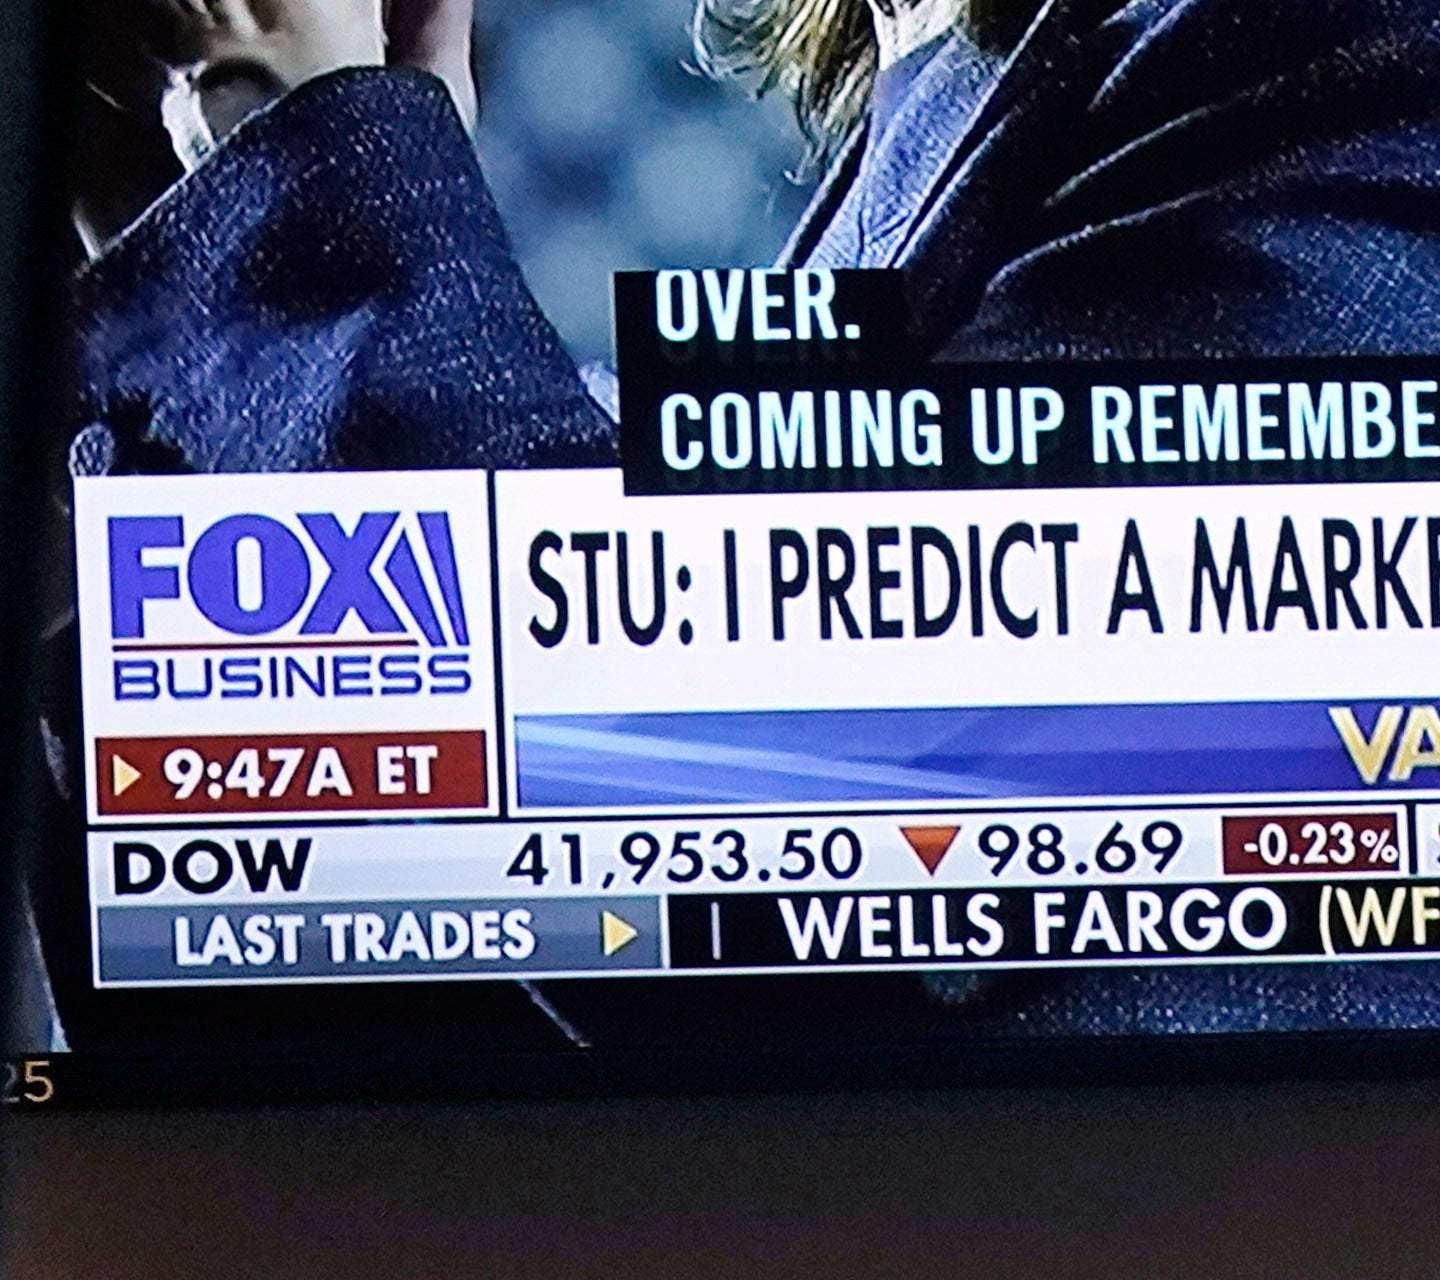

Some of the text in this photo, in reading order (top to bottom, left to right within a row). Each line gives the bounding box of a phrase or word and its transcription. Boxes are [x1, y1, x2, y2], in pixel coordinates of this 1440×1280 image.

[654, 270, 862, 343] OVER.
[659, 388, 944, 472] COMING
[969, 386, 1066, 466] UP
[107, 511, 422, 640] FOX
[527, 528, 695, 650] STU:
[722, 528, 741, 644] I
[768, 520, 1080, 643] PREDICT
[1105, 517, 1165, 636] A
[112, 652, 473, 703] BUSINESS
[163, 744, 439, 801] 9:47A ET
[112, 836, 314, 897] DOW
[505, 826, 864, 889] 41,953.50
[975, 822, 1185, 879] 98.69
[1242, 820, 1400, 874] -0.23%
[174, 907, 536, 967] LAST TRADES
[777, 893, 1006, 960] WELLS
[1032, 887, 1290, 953] FARGO
